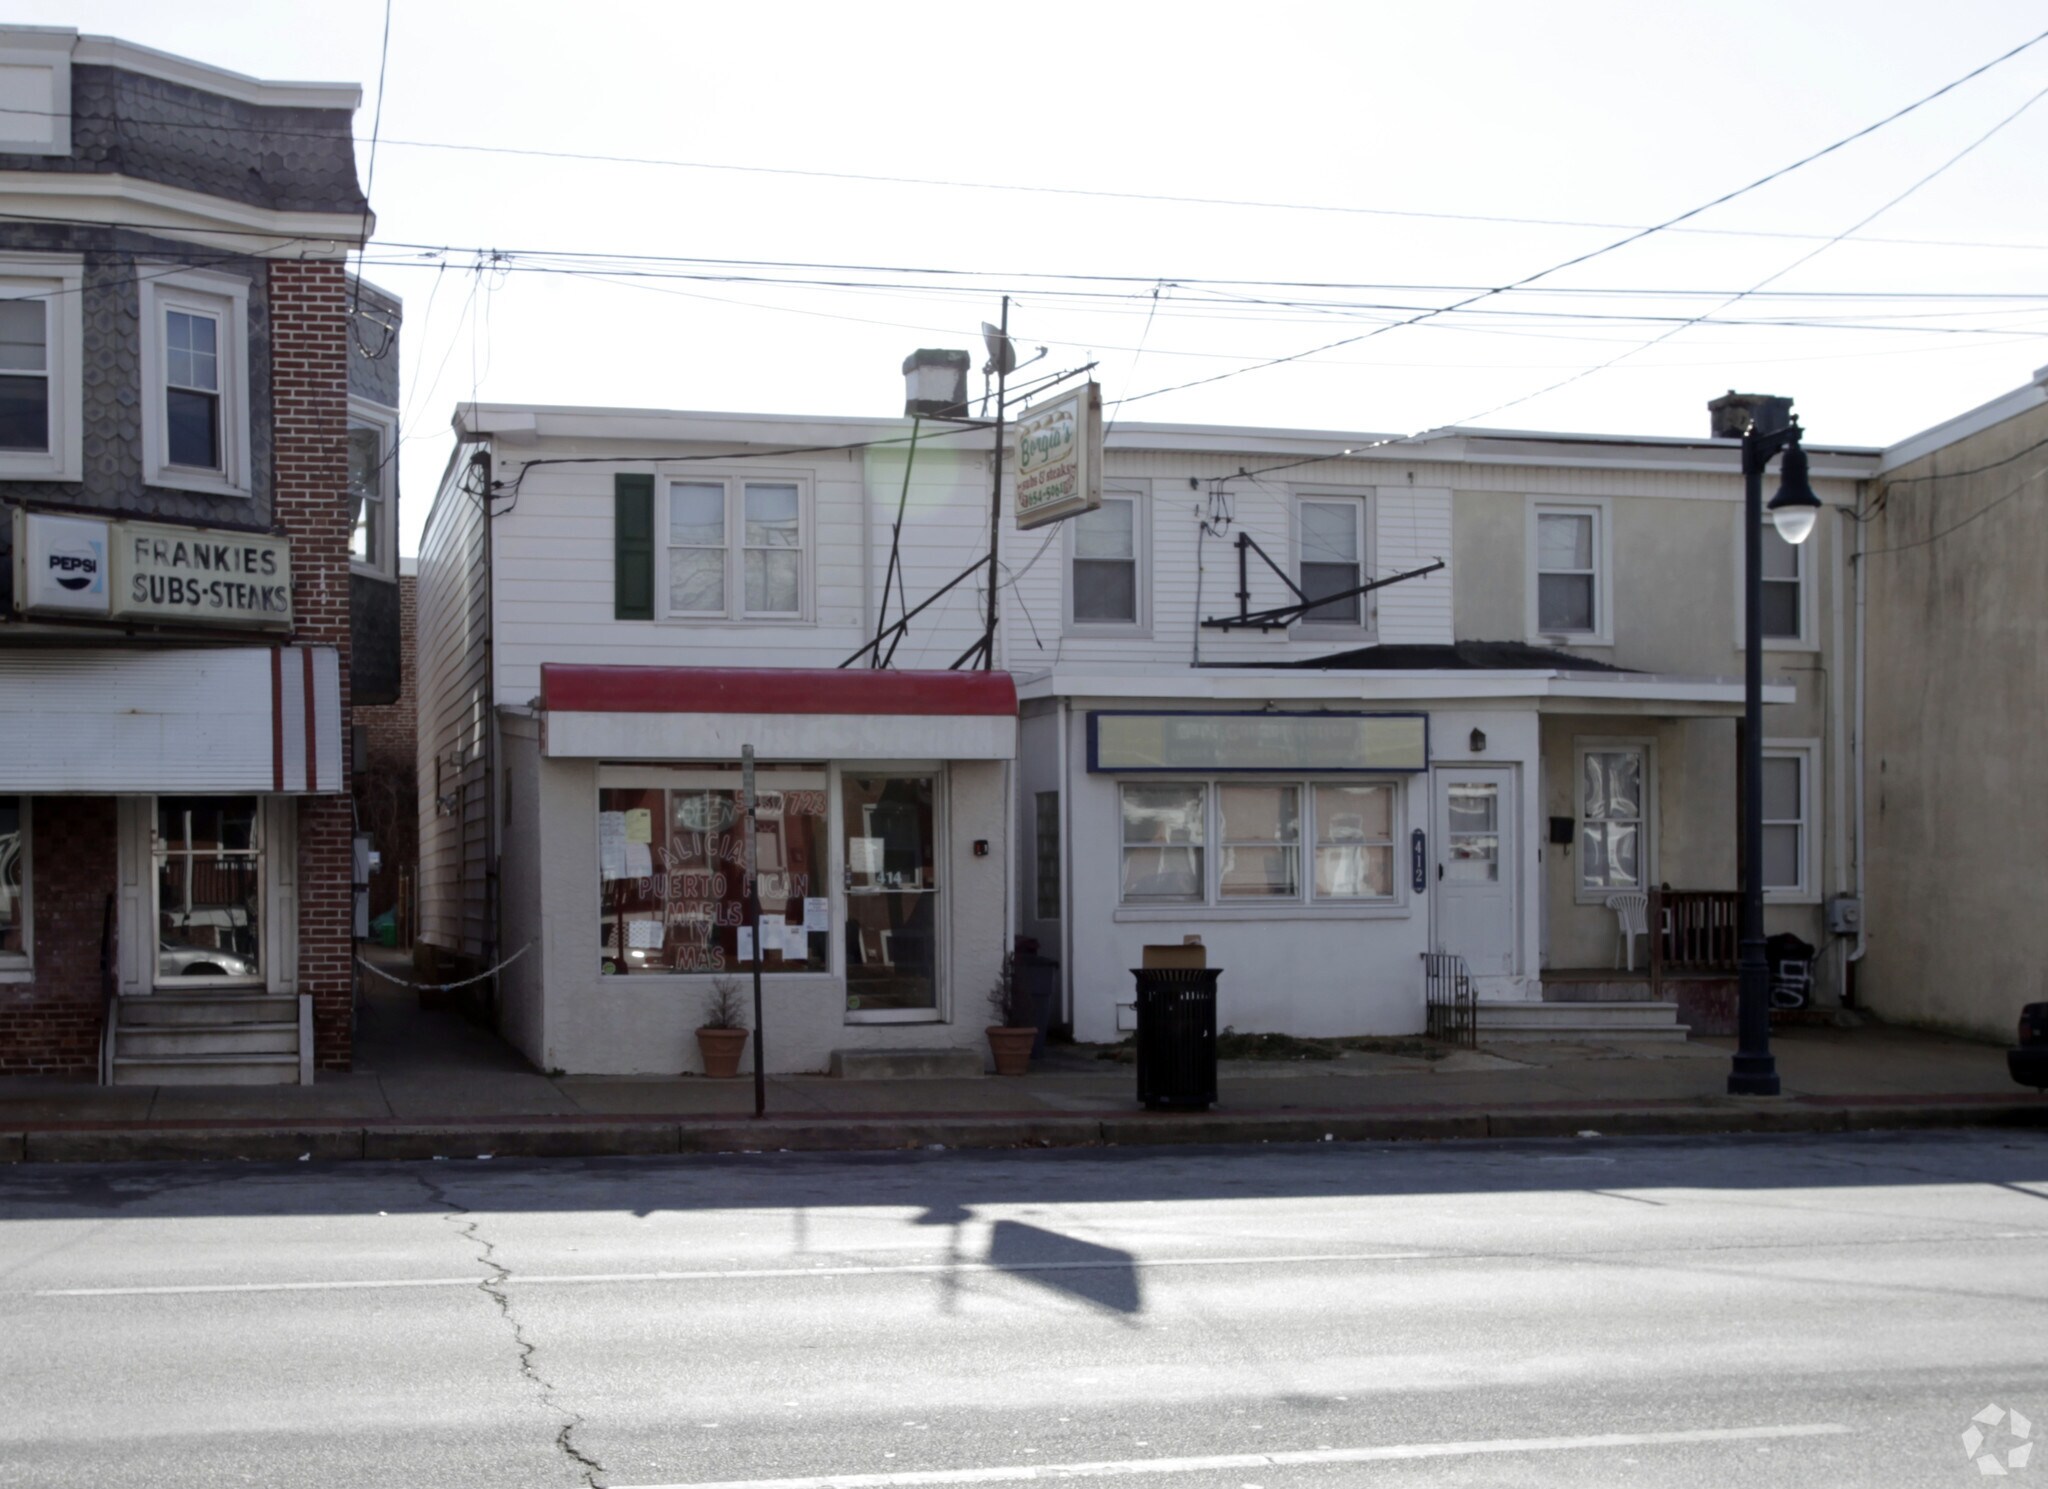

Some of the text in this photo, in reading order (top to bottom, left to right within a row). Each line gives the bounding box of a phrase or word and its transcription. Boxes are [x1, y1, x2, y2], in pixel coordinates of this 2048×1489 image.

[49, 555, 97, 573] PEPSI
[134, 538, 278, 576] FRANKIES
[683, 804, 736, 823] OPEN
[1414, 840, 1423, 882] 412
[638, 873, 727, 899] PUERTO
[877, 871, 902, 885] 414
[665, 901, 743, 927] MAELS
[695, 920, 711, 948] Y
[676, 946, 726, 971] MAS
